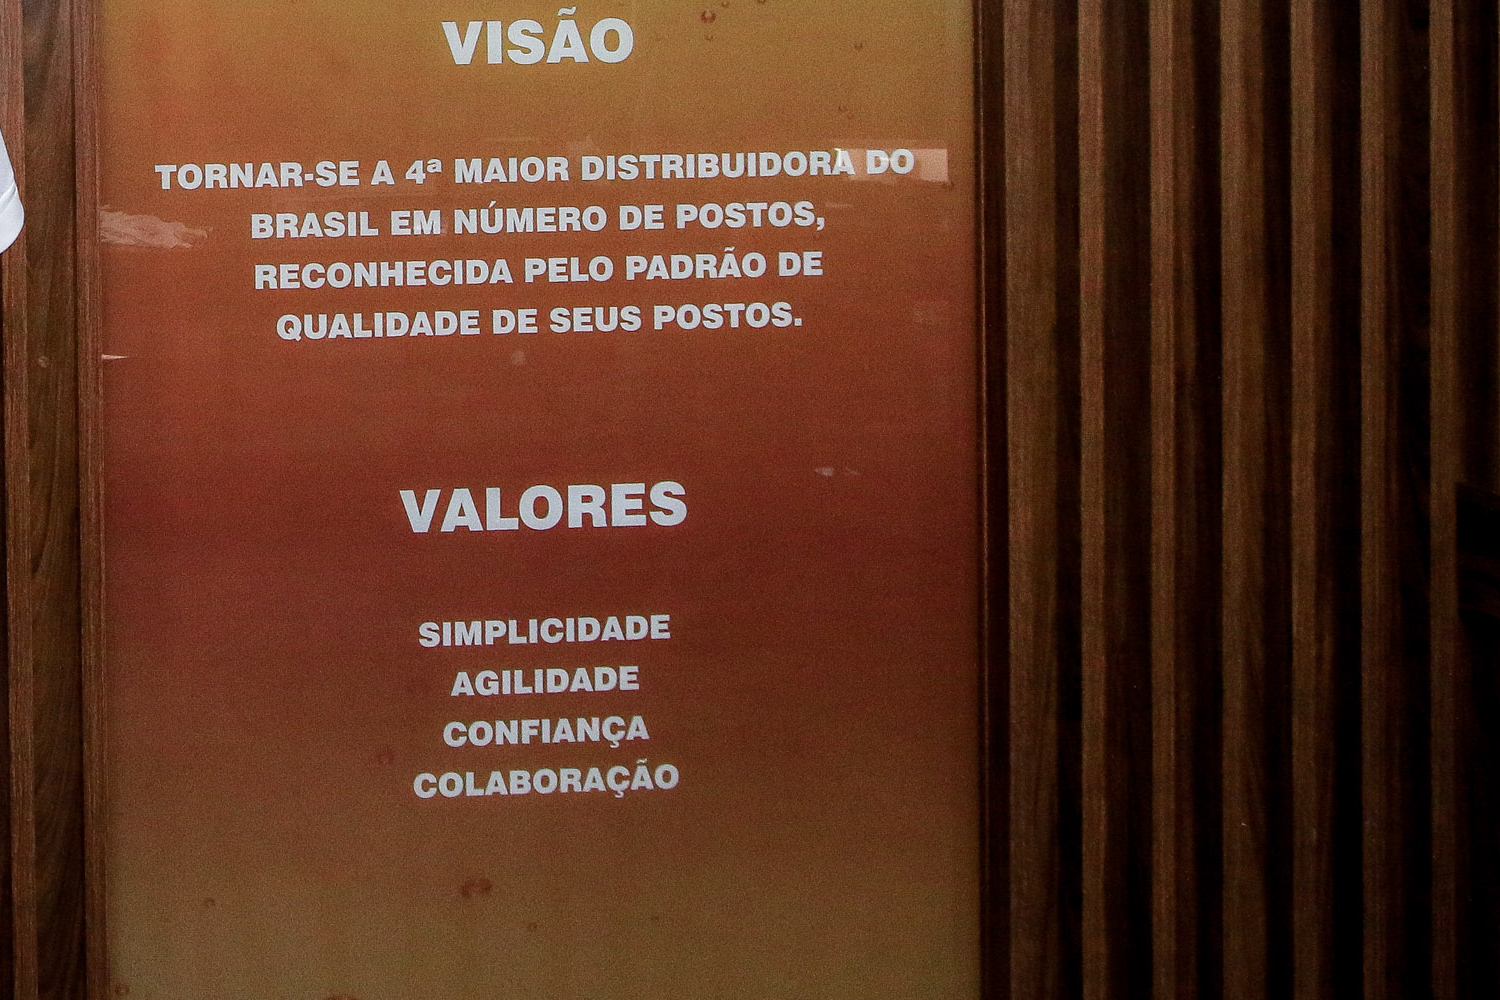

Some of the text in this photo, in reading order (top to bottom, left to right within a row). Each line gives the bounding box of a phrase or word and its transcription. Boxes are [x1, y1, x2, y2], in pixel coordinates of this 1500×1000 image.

[442, 7, 634, 64] VISÃO
[155, 148, 914, 189] TORNAR-SE A 4ª MAIOR DISTRIBUIDORA DO
[252, 201, 824, 238] BRASIL EM NÚMERO DE POSTOS,
[255, 247, 823, 289] RECONHECIDA PELO PADRÃO DE
[277, 302, 802, 341] QUALIDADE DE SEUS POSTOS.
[400, 481, 687, 533] VALORES
[419, 615, 670, 647] SIMPLICIDADE
[451, 666, 639, 696] AGILIDADE
[444, 716, 649, 748] CONFIANÇA
[414, 759, 679, 798] COLABORAÇÃO
